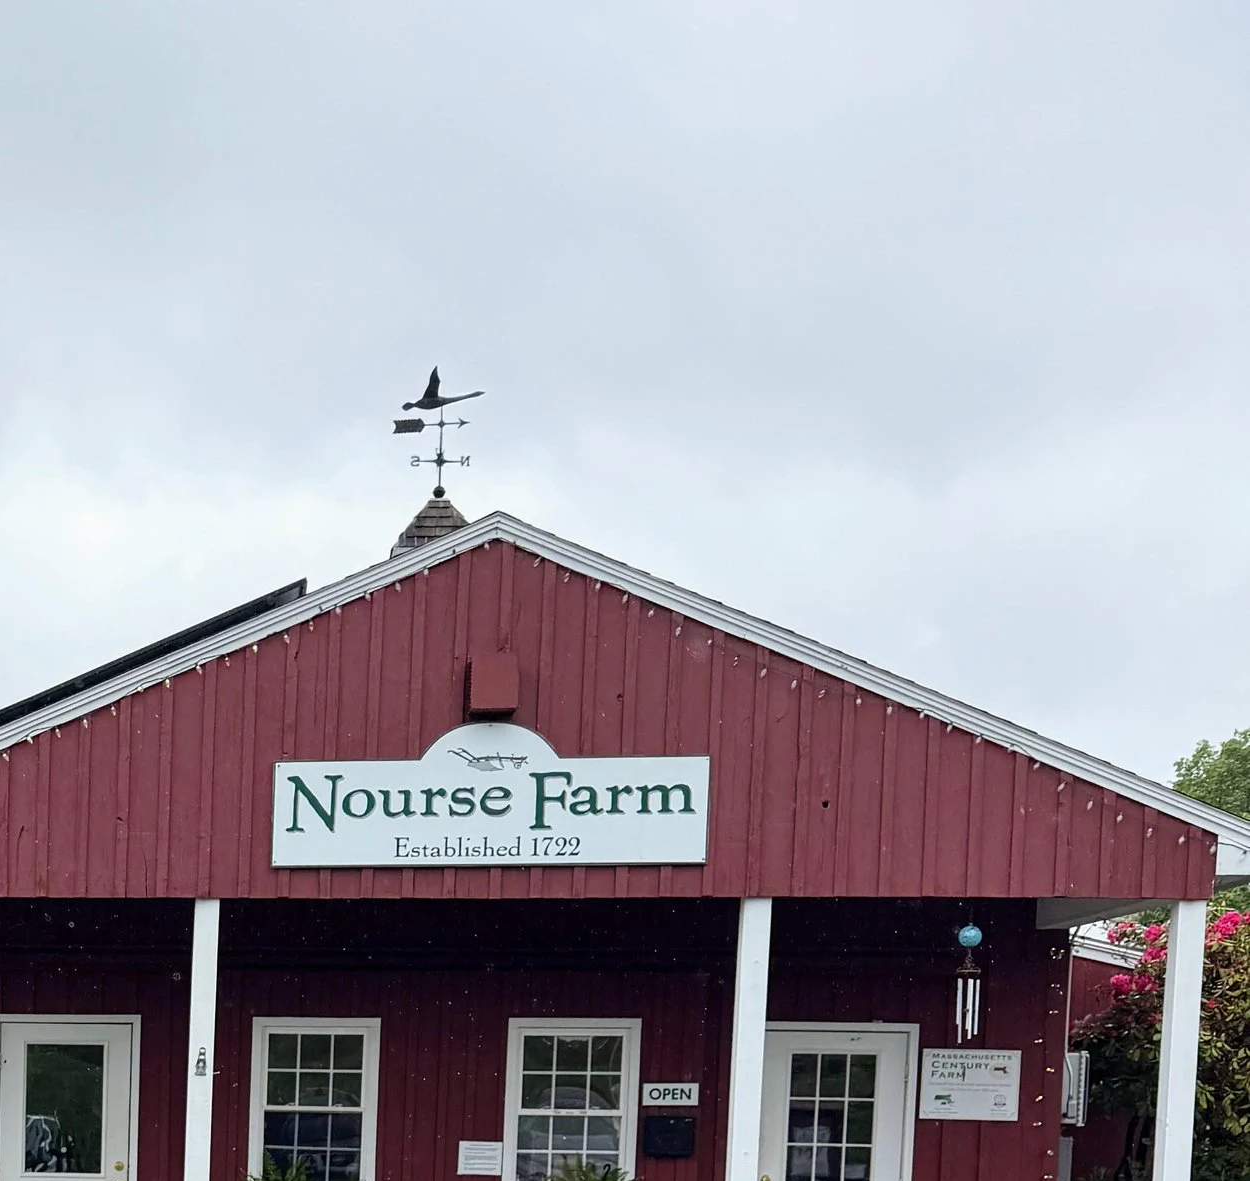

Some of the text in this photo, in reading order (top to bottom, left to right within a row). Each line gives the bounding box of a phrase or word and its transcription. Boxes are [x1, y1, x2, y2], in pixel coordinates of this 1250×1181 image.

[285, 771, 698, 833] Nourse Farm
[394, 836, 581, 858] Established 1722
[931, 1052, 1012, 1061] MASSACHUSETTS
[931, 1060, 990, 1070] CENTURY
[931, 1070, 964, 1079] FARM
[649, 1087, 692, 1101] OPEN
